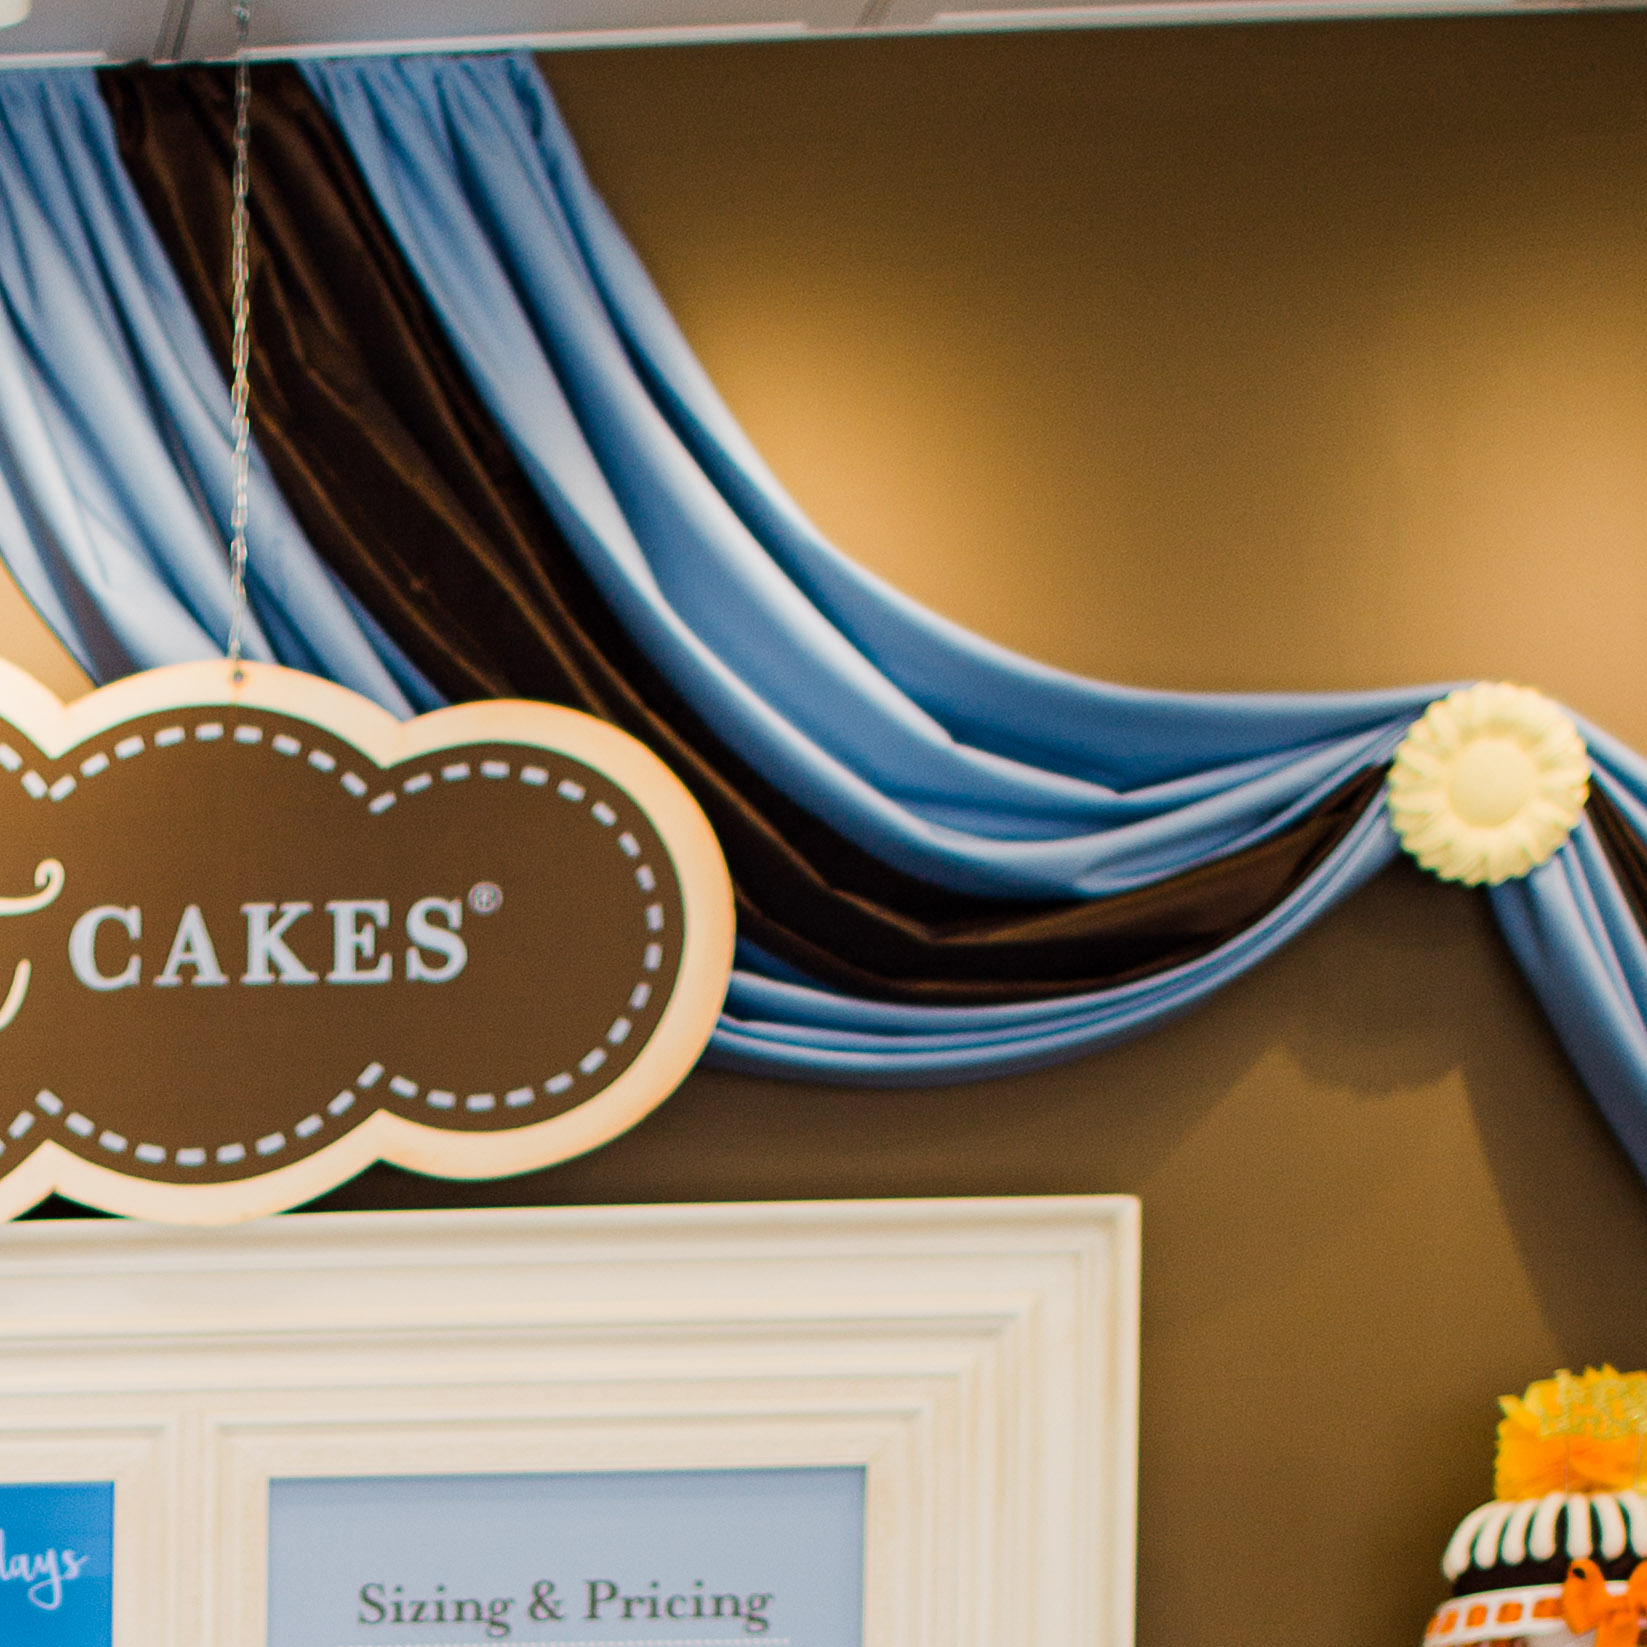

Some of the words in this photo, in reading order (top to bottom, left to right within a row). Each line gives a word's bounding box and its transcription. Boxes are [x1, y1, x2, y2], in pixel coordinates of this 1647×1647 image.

[357, 1583, 514, 1637] Sizing
[528, 1580, 564, 1621] &
[584, 1578, 773, 1633] Pricing
